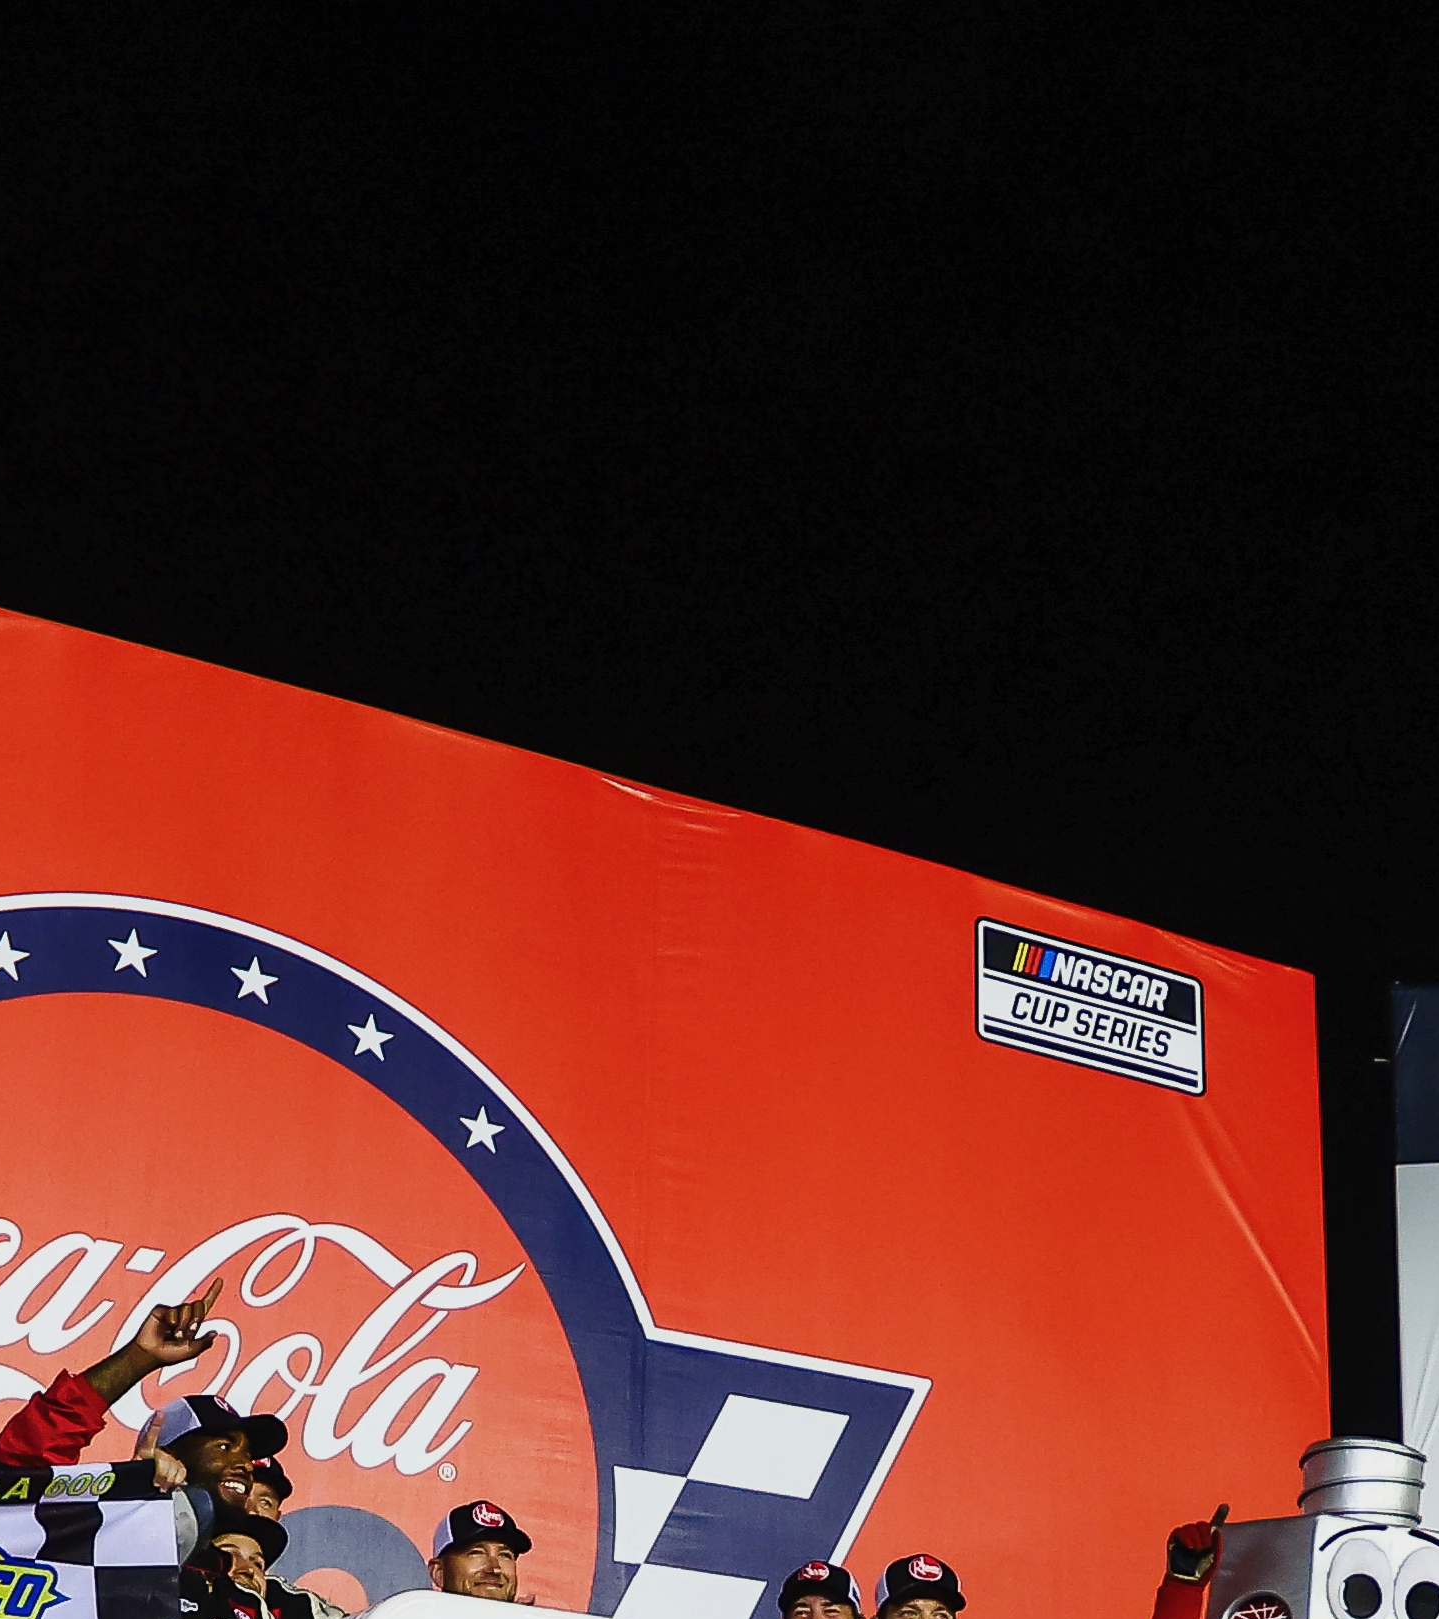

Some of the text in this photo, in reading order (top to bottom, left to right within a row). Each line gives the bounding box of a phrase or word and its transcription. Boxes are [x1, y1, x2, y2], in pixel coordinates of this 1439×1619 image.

[1051, 953, 1169, 1012] NASCAR
[1011, 992, 1172, 1057] CUP SERIES
[45, 1471, 115, 1497] 600
